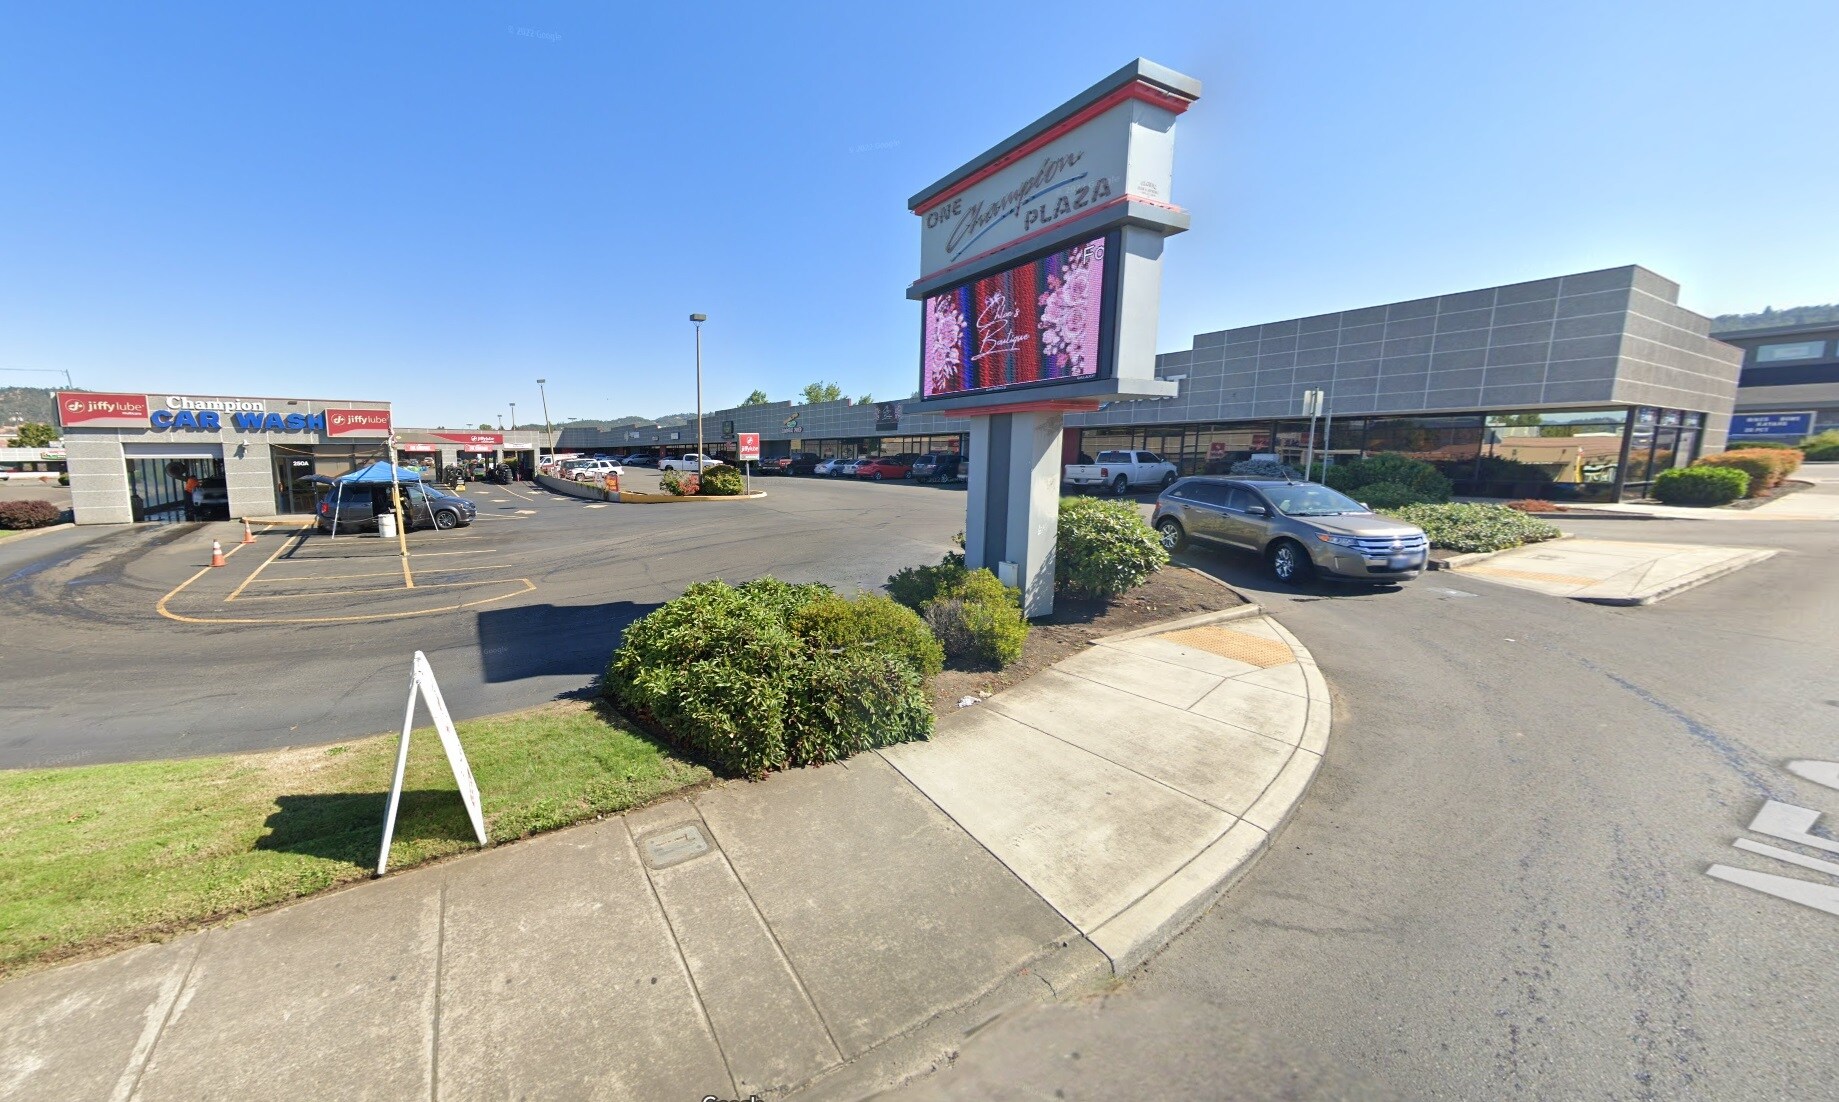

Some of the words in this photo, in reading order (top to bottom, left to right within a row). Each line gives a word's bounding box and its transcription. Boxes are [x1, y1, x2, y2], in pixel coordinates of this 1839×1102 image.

[926, 198, 962, 229] ONE
[945, 150, 1085, 253] Champion
[1024, 177, 1112, 231] PLAZA
[971, 320, 1030, 361] Boutique
[151, 409, 221, 430] CAR
[234, 411, 325, 430] WASH
[165, 396, 264, 414] Champion
